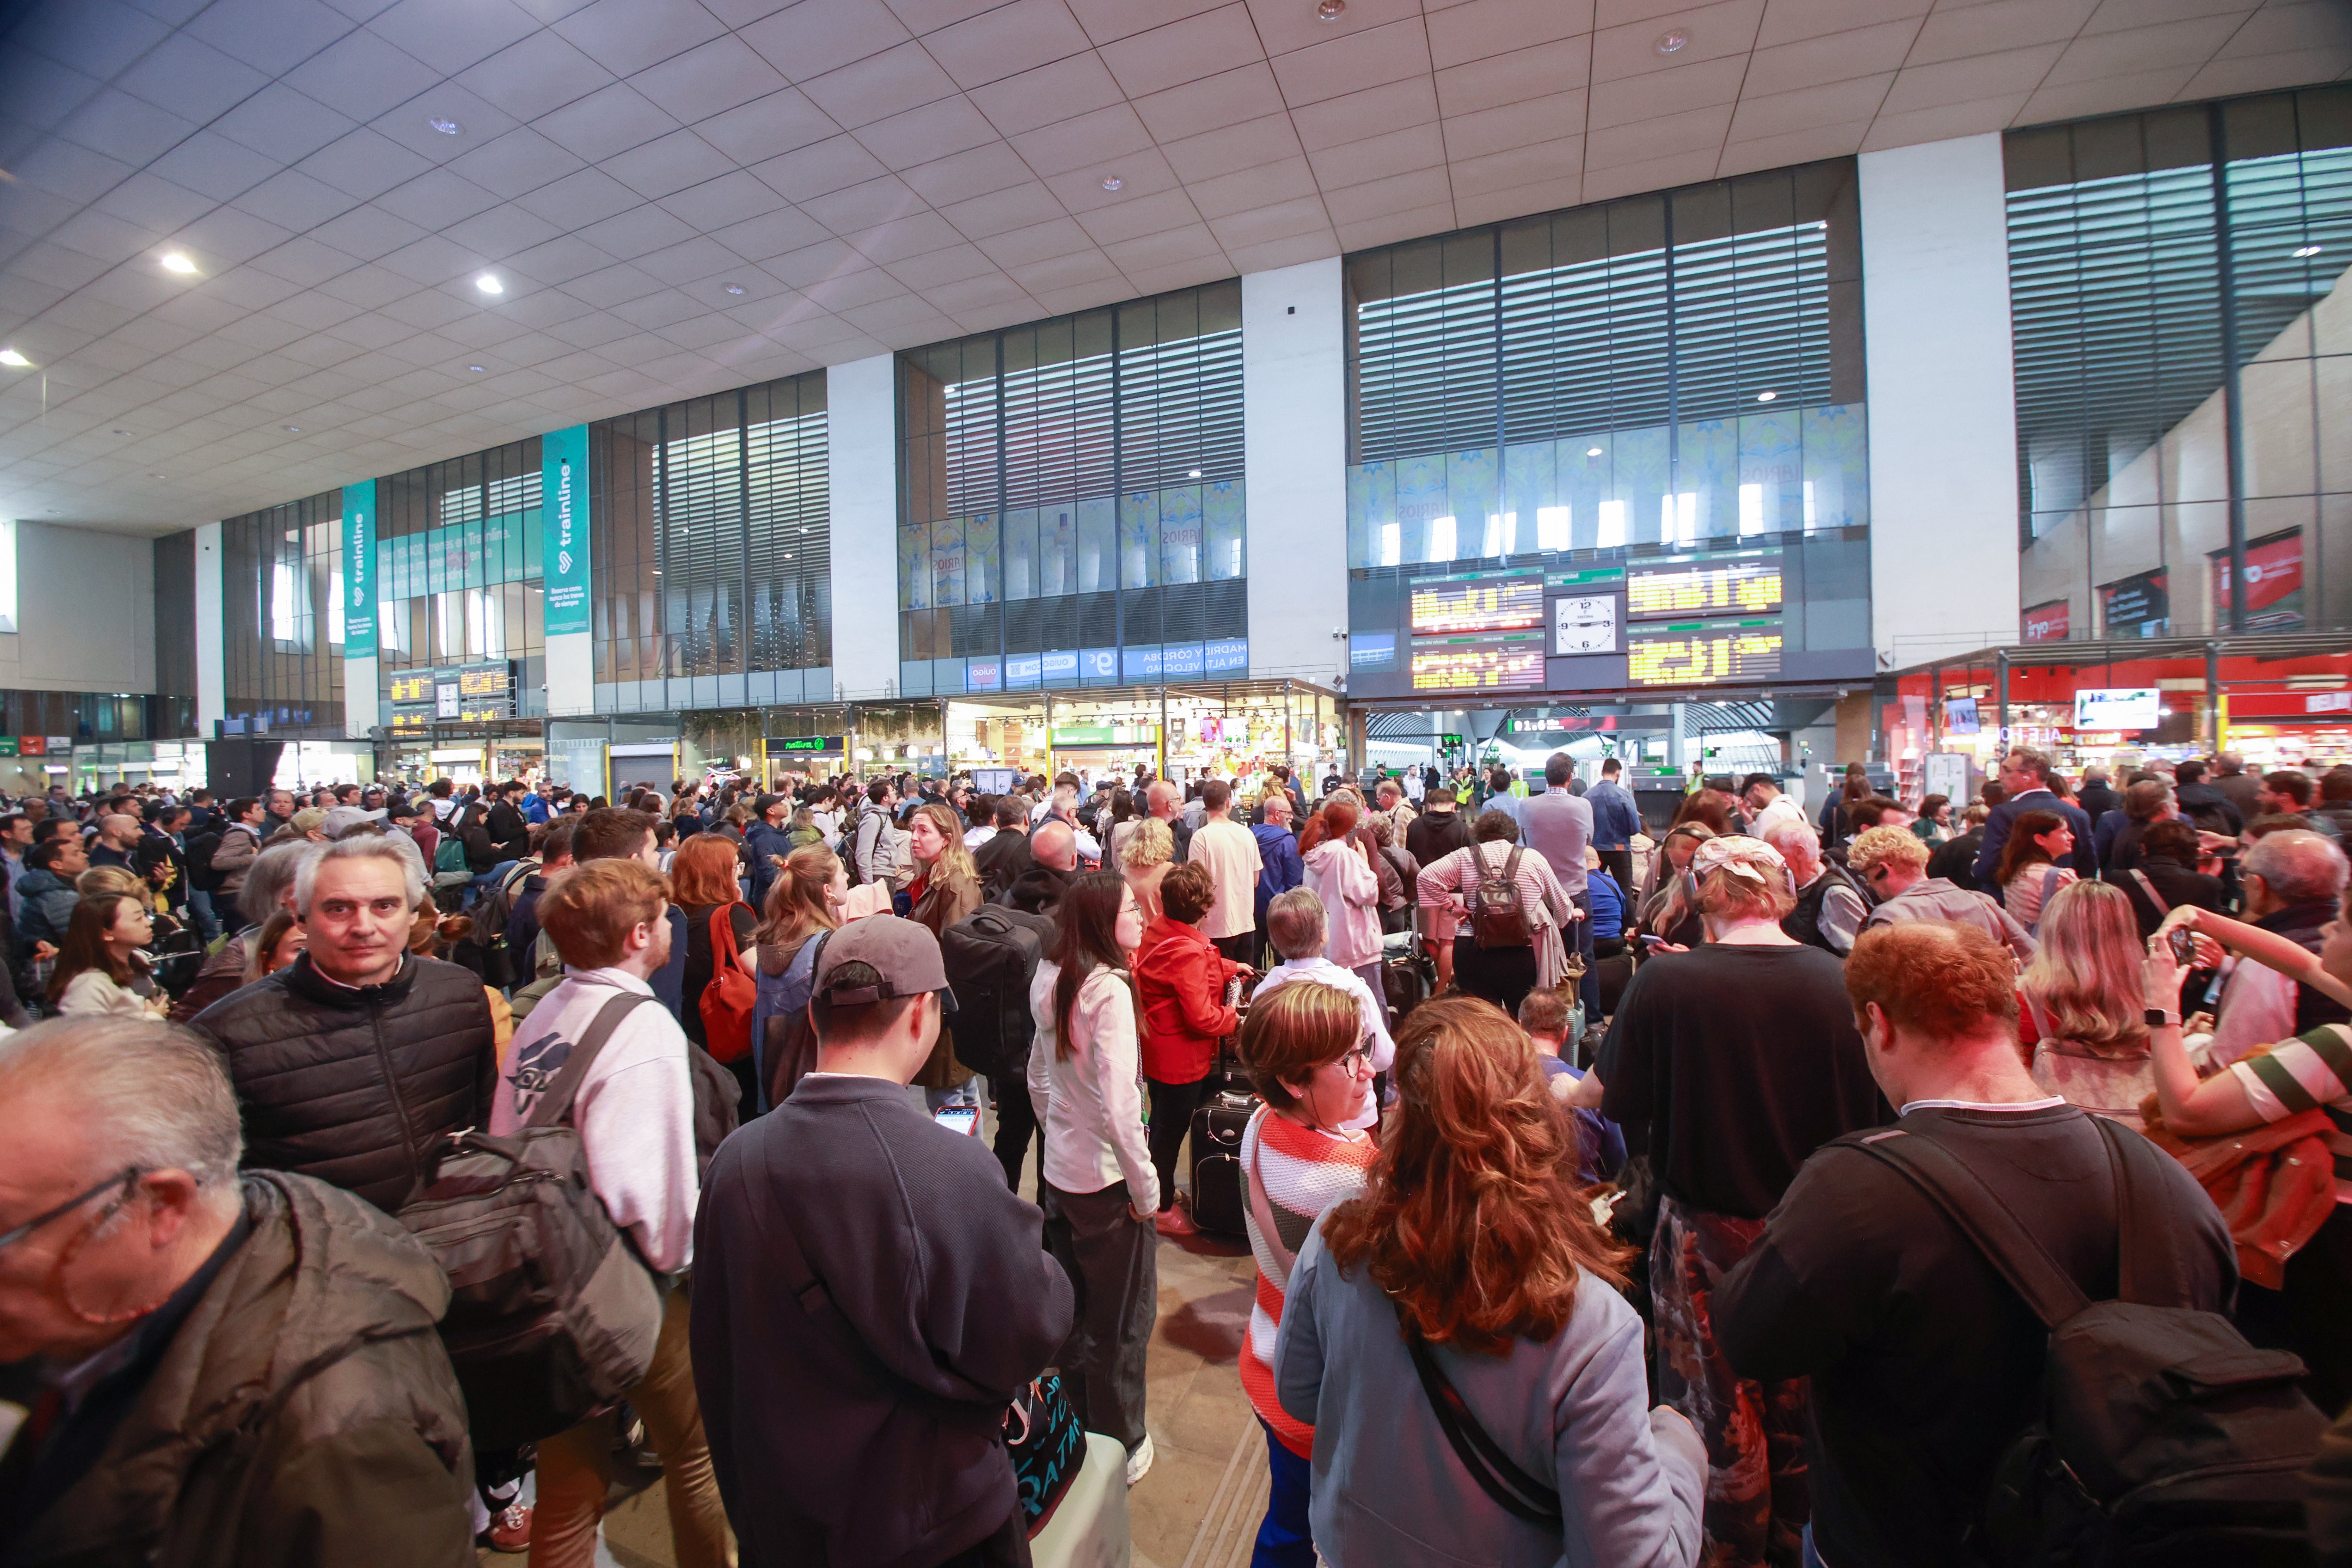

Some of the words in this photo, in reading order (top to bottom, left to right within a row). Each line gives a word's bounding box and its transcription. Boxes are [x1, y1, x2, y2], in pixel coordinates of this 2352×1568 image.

[558, 465, 572, 547] trainline
[468, 528, 511, 545] Tranline.
[353, 514, 364, 584] trainline
[514, 564, 542, 576] tranline
[2028, 620, 2049, 639] iryo
[785, 740, 814, 750] natura
